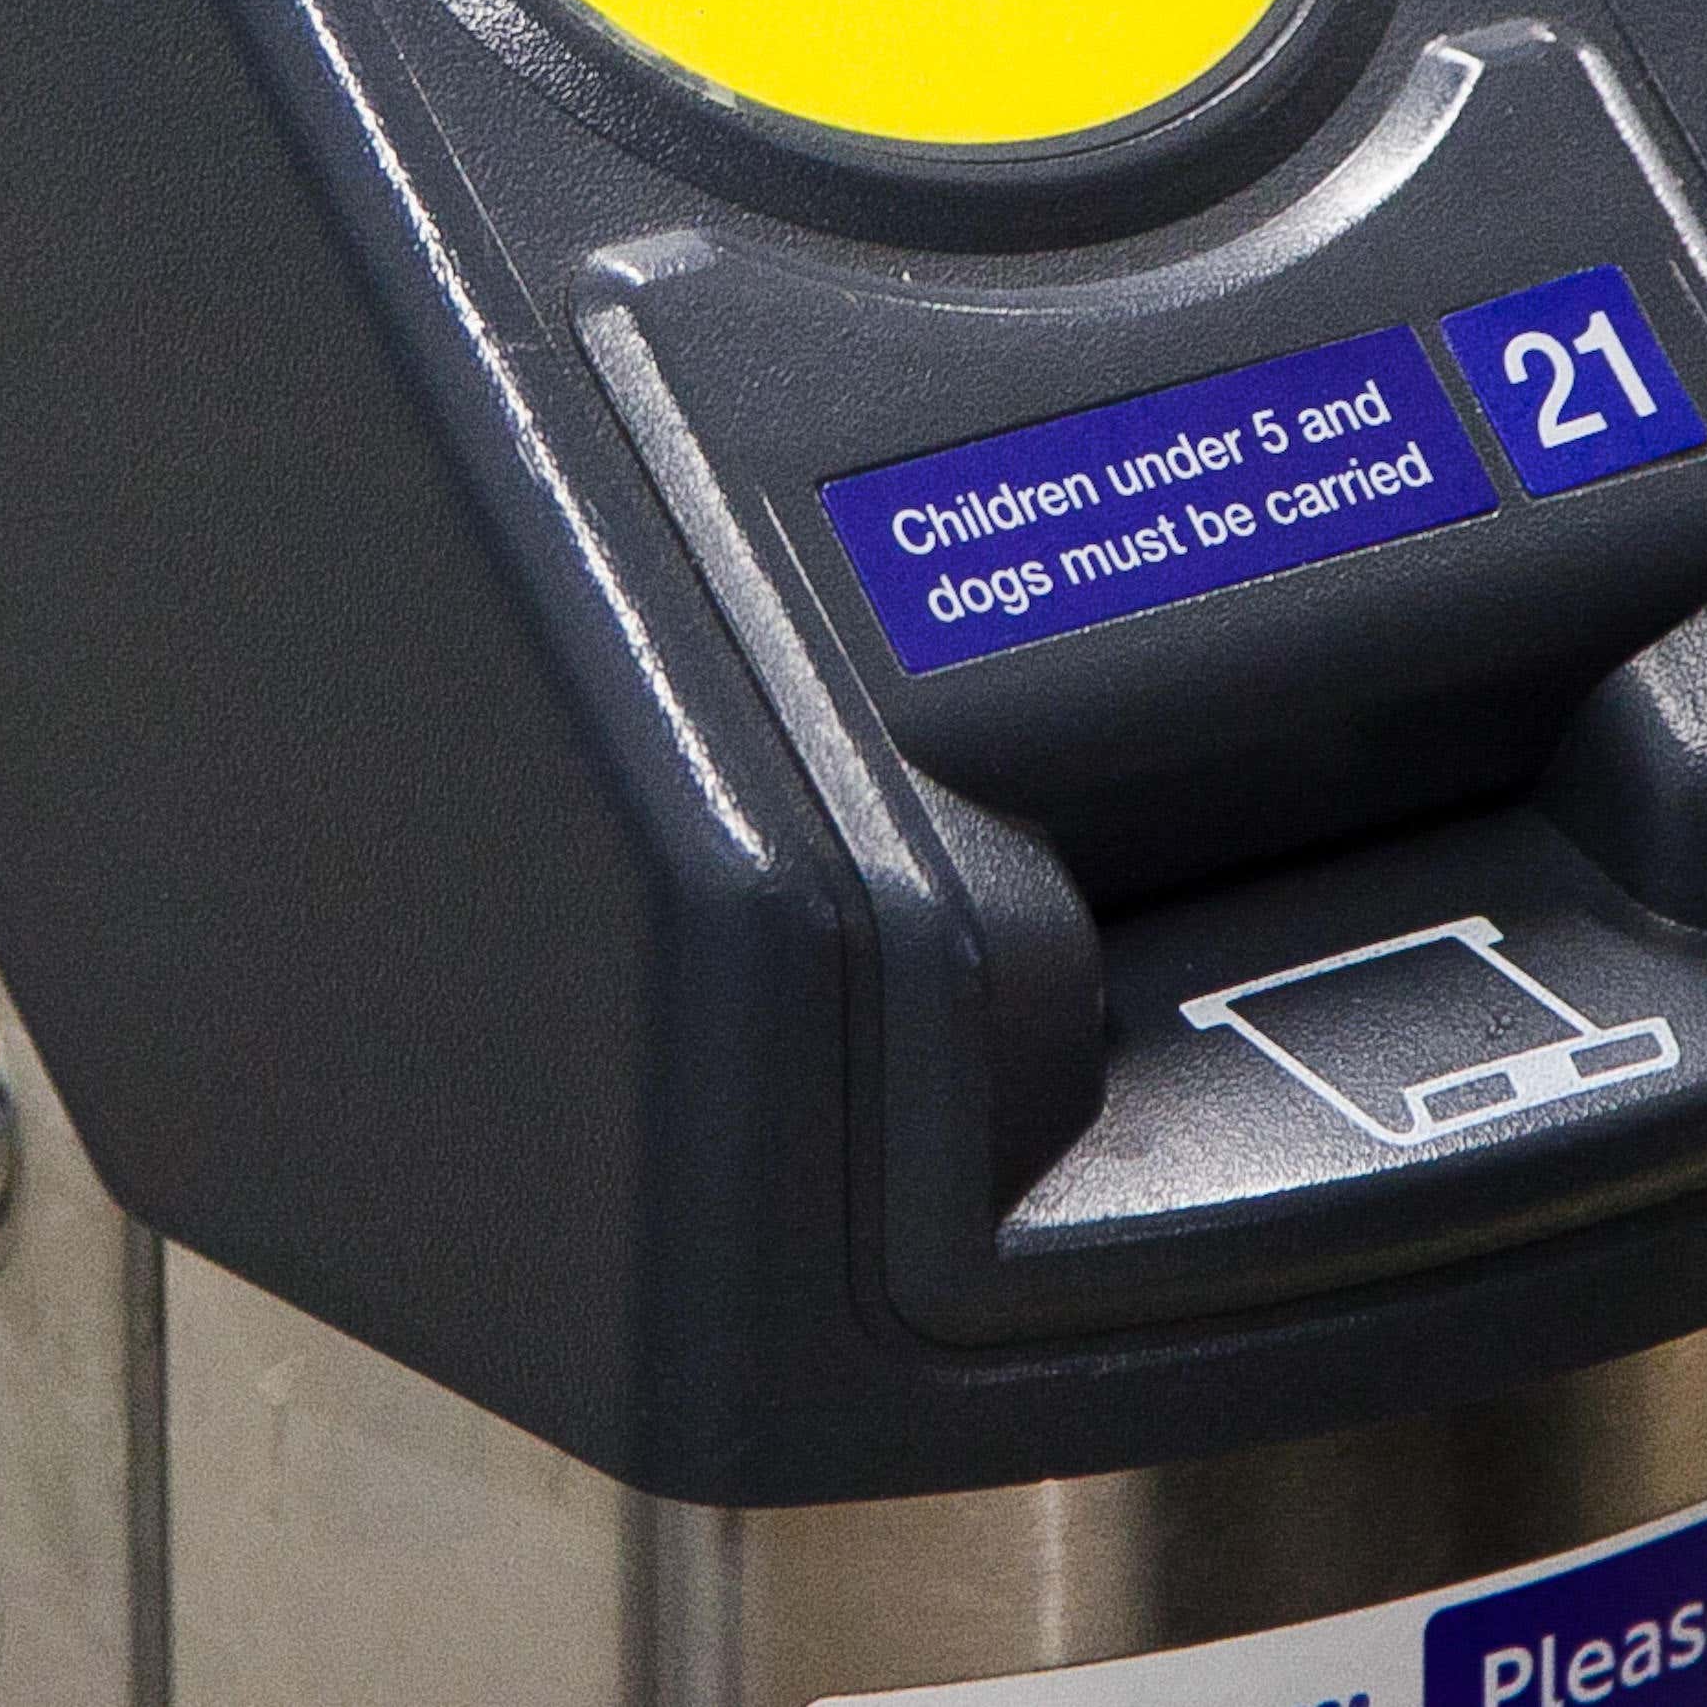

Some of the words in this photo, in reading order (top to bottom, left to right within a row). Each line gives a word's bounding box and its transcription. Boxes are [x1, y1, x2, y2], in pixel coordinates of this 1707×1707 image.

[892, 482, 1100, 556] Children
[1105, 432, 1243, 496] under
[1252, 408, 1290, 454] 5
[1297, 379, 1392, 443] and
[1503, 311, 1658, 448] 21
[927, 560, 1054, 622] dogs
[1059, 515, 1188, 585] must
[1185, 503, 1257, 547] be
[1265, 441, 1434, 525] carried
